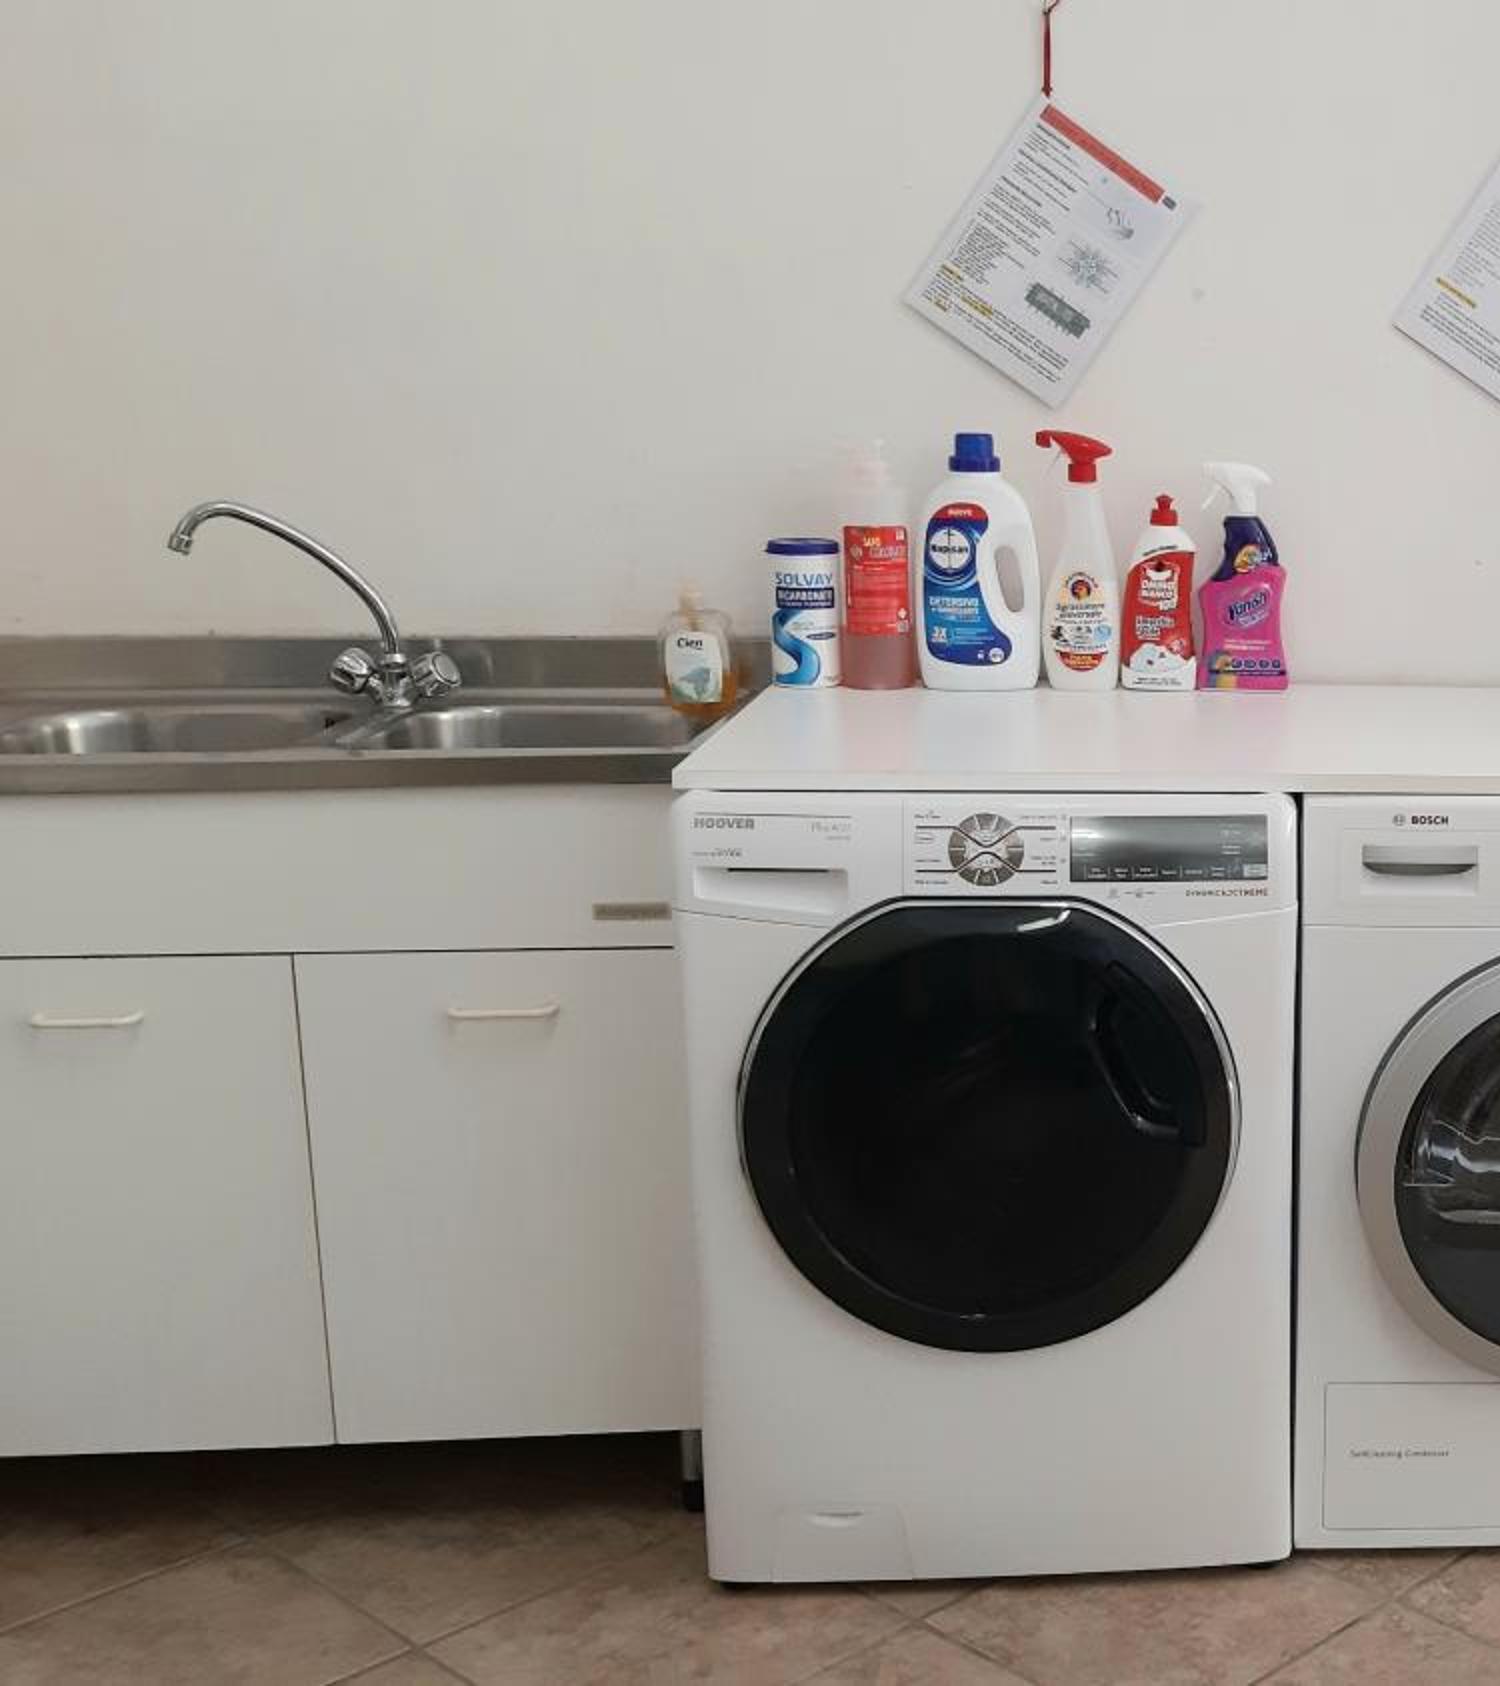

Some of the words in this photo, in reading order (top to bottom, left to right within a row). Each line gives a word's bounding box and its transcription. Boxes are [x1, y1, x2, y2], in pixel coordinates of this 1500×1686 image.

[930, 543, 968, 554] Napisan
[775, 572, 833, 586] SOLVAY
[677, 637, 703, 649] Cien
[693, 817, 755, 830] HOOVER
[1411, 815, 1449, 825] BOSCH
